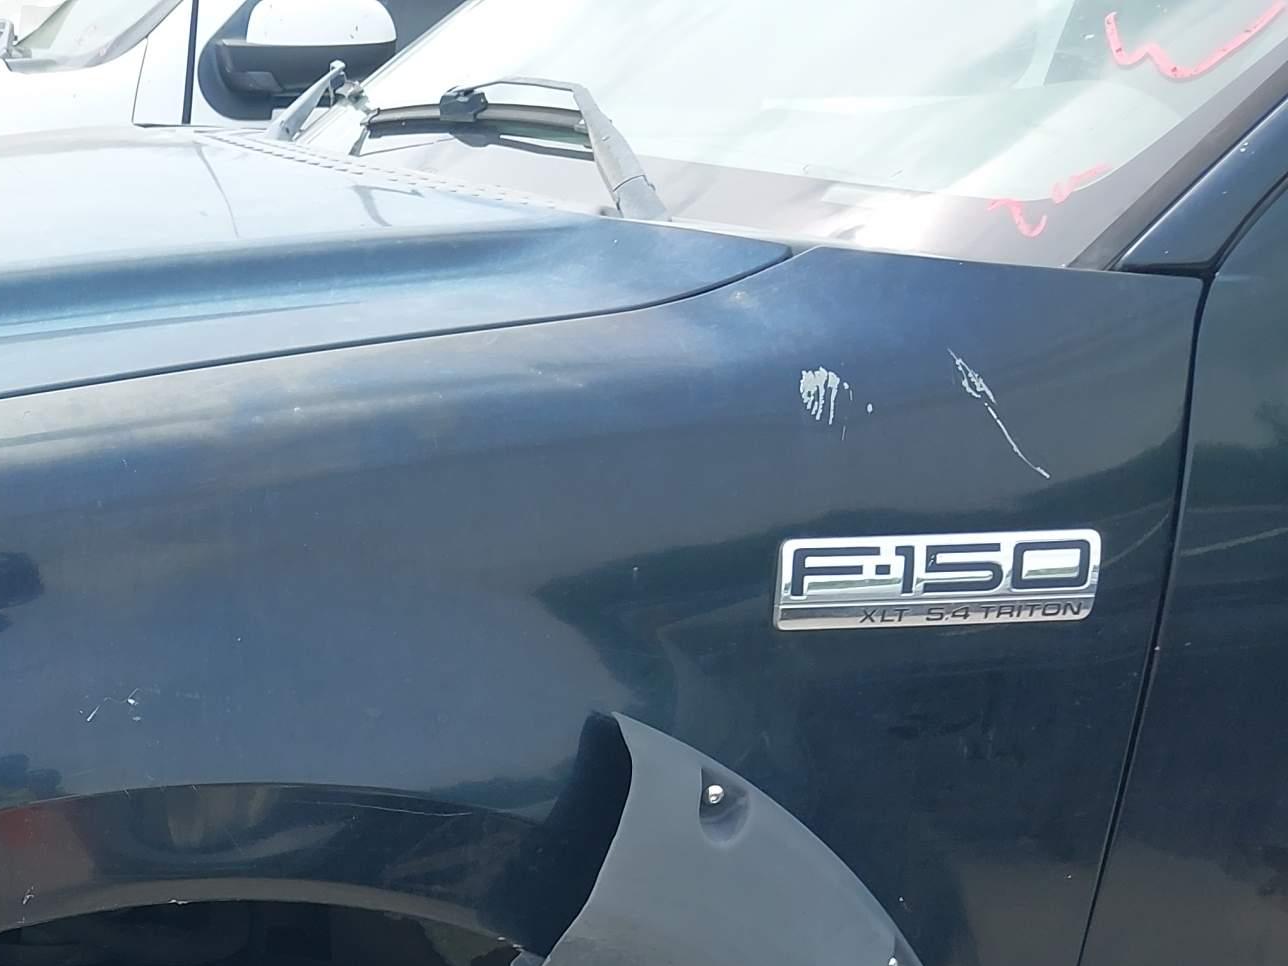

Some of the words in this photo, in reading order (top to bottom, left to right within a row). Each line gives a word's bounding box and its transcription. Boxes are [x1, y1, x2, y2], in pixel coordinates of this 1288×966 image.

[859, 607, 910, 624] XLT
[924, 605, 971, 622] 5.4
[980, 601, 1083, 619] TRITON
